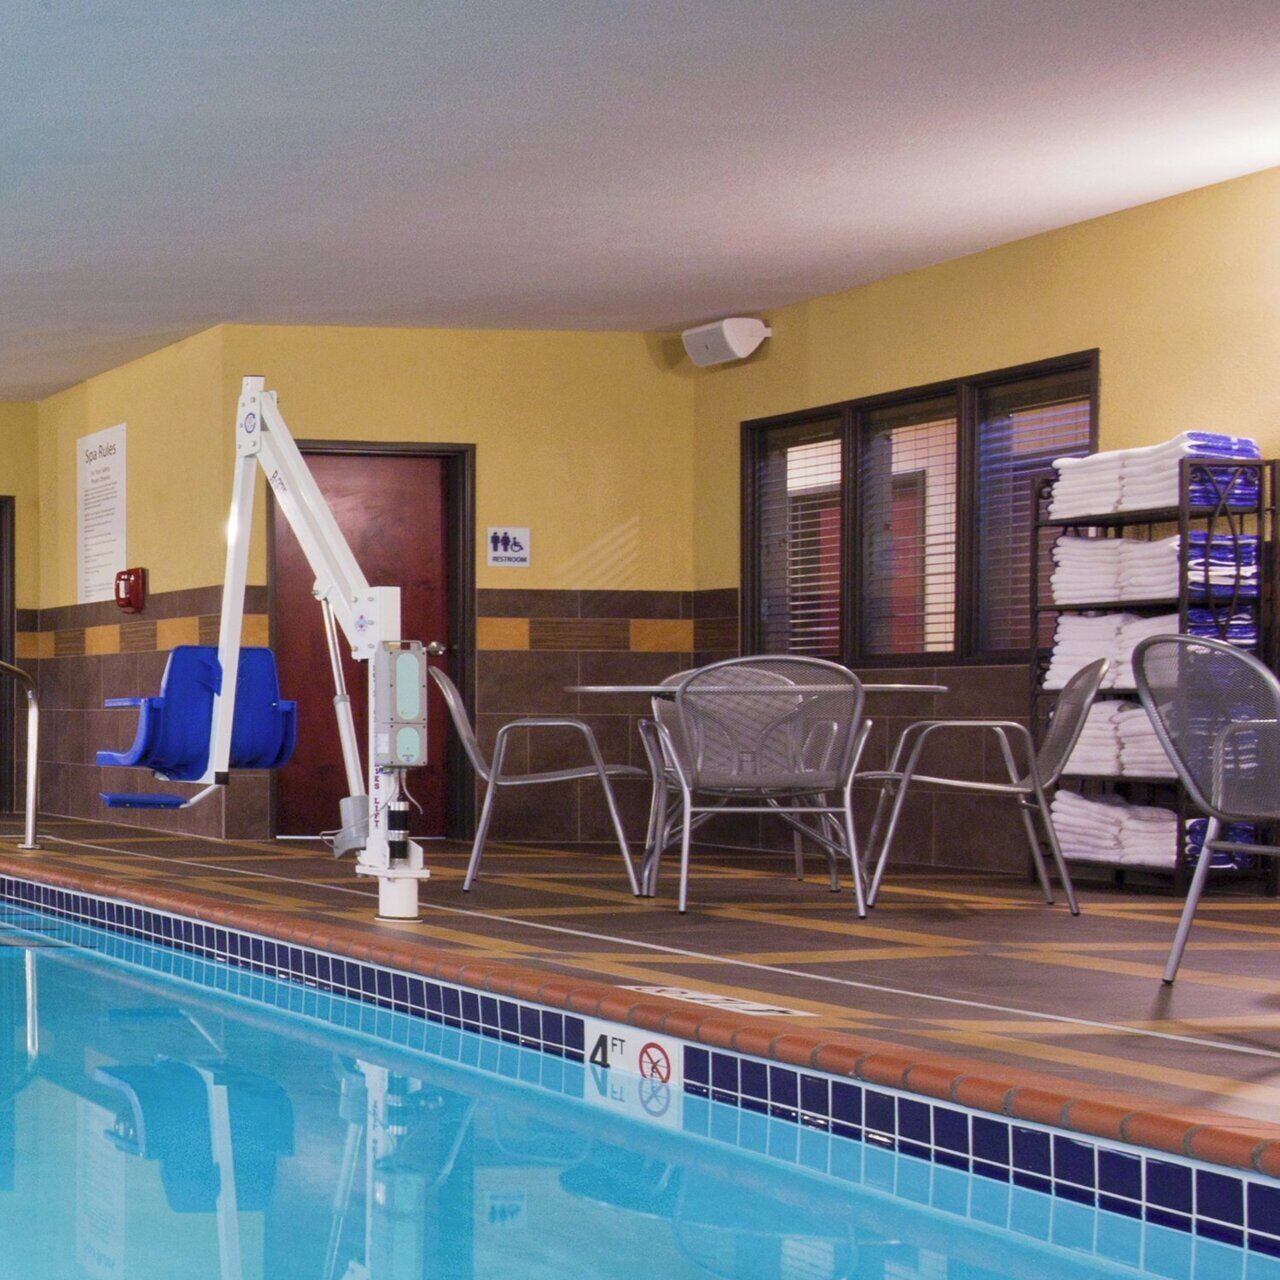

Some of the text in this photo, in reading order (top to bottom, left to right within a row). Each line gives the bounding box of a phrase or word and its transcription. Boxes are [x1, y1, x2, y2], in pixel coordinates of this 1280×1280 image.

[85, 442, 117, 465] Spa Rules
[589, 1034, 626, 1068] 4 FT
